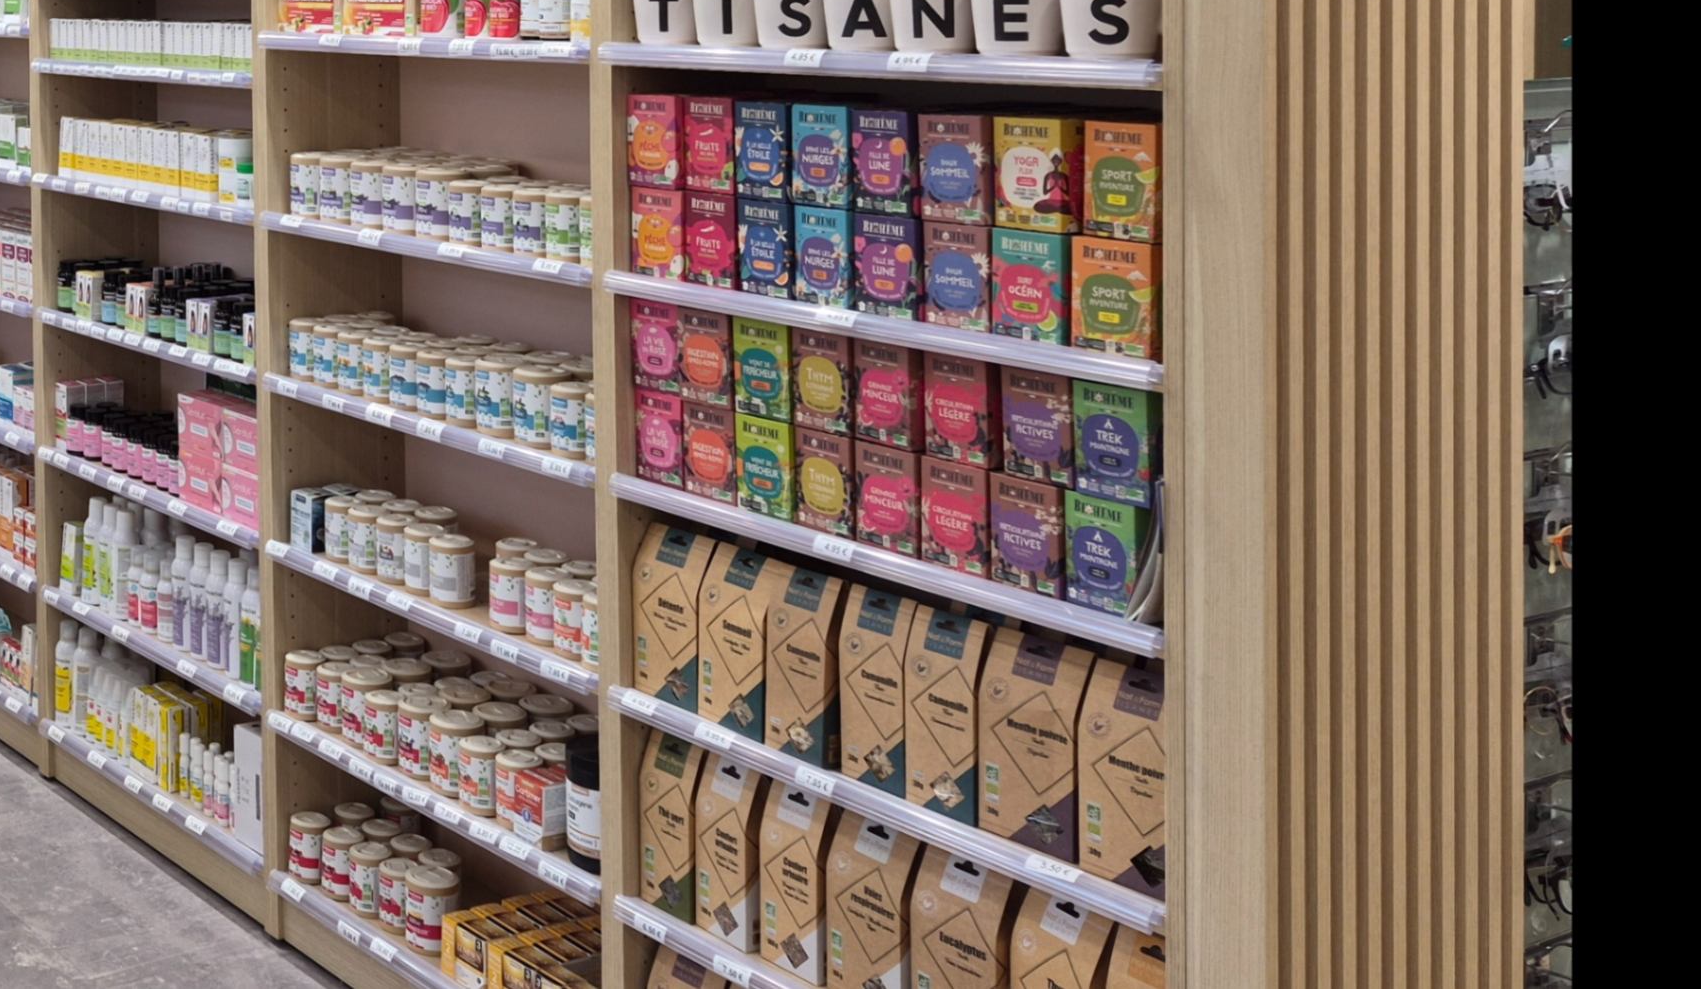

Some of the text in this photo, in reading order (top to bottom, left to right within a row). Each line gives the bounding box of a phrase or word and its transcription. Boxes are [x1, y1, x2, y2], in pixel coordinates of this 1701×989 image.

[695, 141, 719, 152] FRUITS
[747, 147, 770, 160] ÉTOILE
[868, 159, 891, 171] LUNE
[930, 166, 970, 179] SOMMEIL
[1101, 169, 1132, 181] SPORT
[696, 236, 720, 248] FRUITS
[751, 246, 774, 259] ÉTOILE
[872, 264, 895, 278] LUNE
[934, 273, 975, 288] SOMMEIL
[1008, 284, 1043, 299] OCÉAN
[1092, 285, 1126, 300] SPORT
[861, 388, 899, 403] MINCEUR
[938, 407, 971, 422] LÉGÈRE
[1015, 423, 1055, 440] ACTIVES
[1096, 429, 1123, 445] TREK
[864, 493, 903, 511] MINCEUR
[935, 514, 969, 532] LÉGÈRE
[1003, 531, 1042, 550] ACTIVES
[1085, 541, 1111, 558] TREK
[1007, 717, 1036, 735] Menthe
[1108, 755, 1140, 774] Menthe
[939, 931, 987, 961] Eucalyptus
